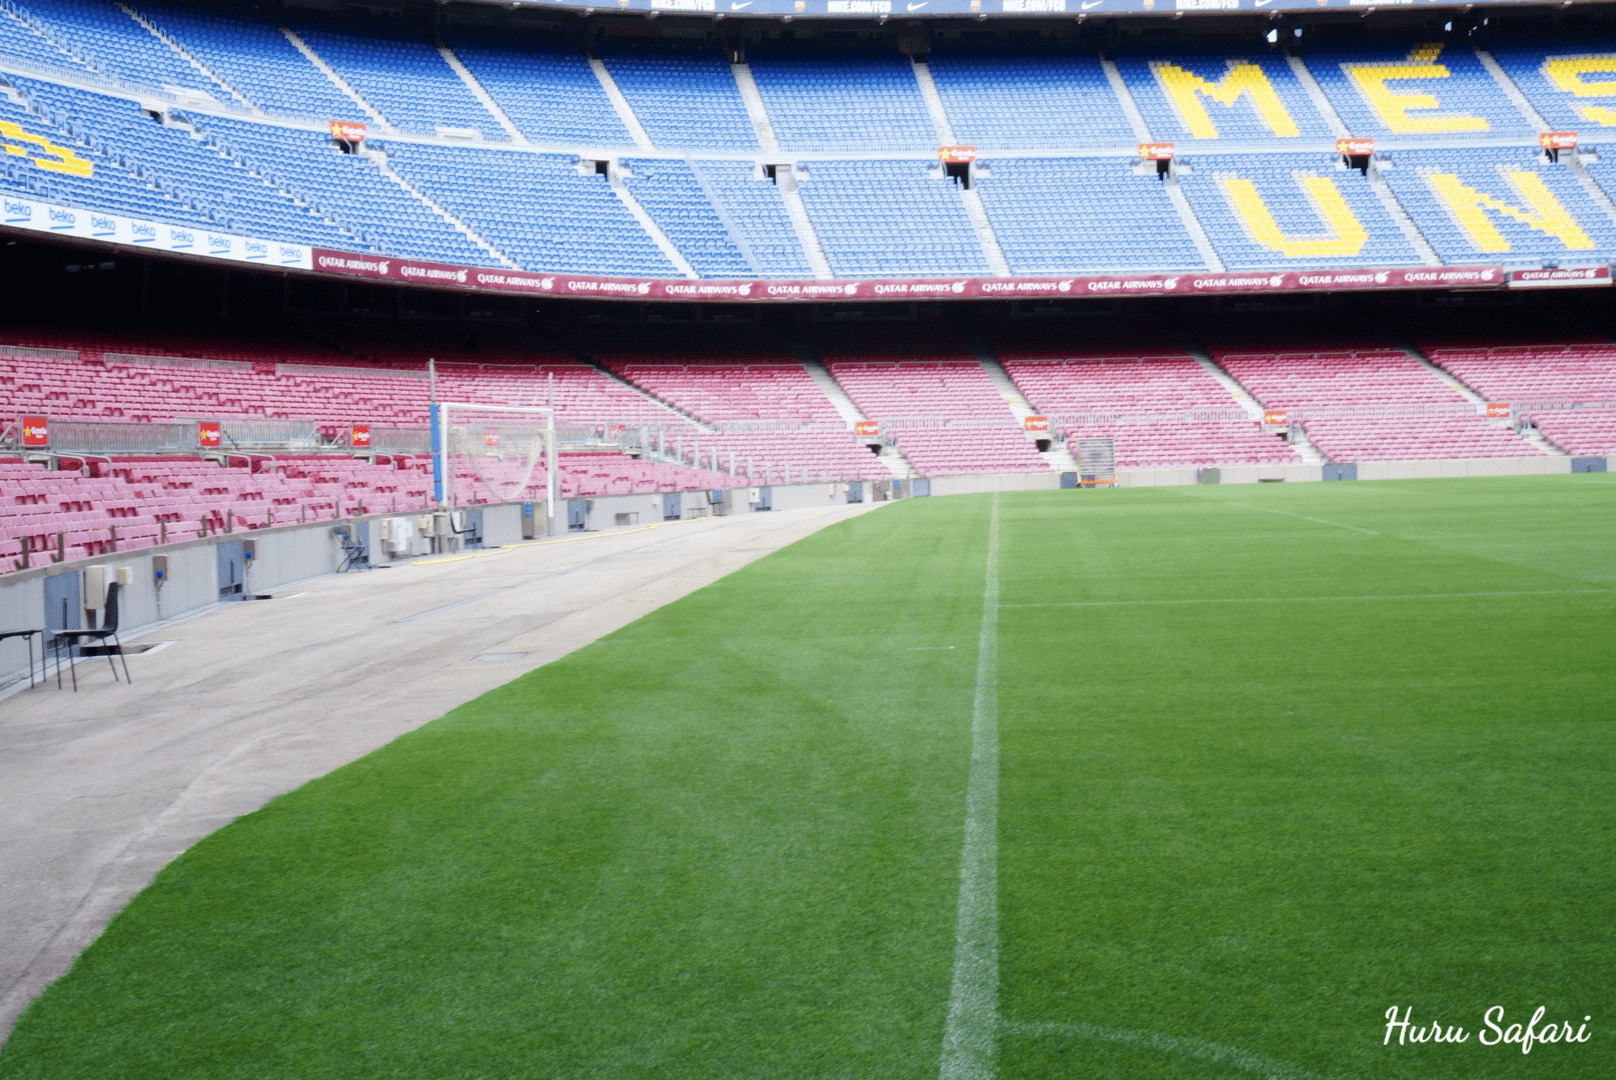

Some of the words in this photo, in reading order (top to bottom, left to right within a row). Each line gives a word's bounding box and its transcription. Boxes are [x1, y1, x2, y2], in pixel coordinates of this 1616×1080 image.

[4, 199, 31, 216] beko
[50, 207, 75, 223] beko
[92, 215, 115, 230] beko
[132, 222, 155, 237] beko
[170, 228, 193, 243] beko
[209, 235, 230, 248] beko
[245, 240, 267, 253] beko
[280, 246, 301, 257] beko
[319, 256, 345, 268] QATAR
[346, 260, 378, 271] AIRWAYS
[401, 266, 424, 277] QATAR
[427, 269, 457, 280] AIRWAYS
[1404, 272, 1436, 281] QATAR
[1439, 271, 1479, 280] AIRWAYS
[1522, 272, 1549, 280] QATAR
[1551, 270, 1584, 279] AIRWAYS
[477, 274, 504, 284] QATAR
[506, 277, 540, 288] AIRWAYS
[1088, 281, 1121, 290] QATAR
[1123, 280, 1163, 289] AIRWAYS
[1194, 279, 1226, 288] QATAR
[1228, 277, 1268, 286] AIRWAYS
[1299, 276, 1331, 285] QATAR
[1333, 274, 1374, 283] AIRWAYS
[568, 280, 598, 290] QATAR
[600, 283, 636, 292] AIRWAYS
[665, 284, 696, 294] QATAR
[698, 285, 737, 294] AIRWAYS
[768, 284, 799, 294] QATAR
[802, 284, 843, 294] AIRWAYS
[875, 284, 908, 294] QATAR
[910, 283, 950, 292] AIRWAYS
[982, 282, 1015, 292] QATAR
[1017, 282, 1057, 291] AIRWAYS
